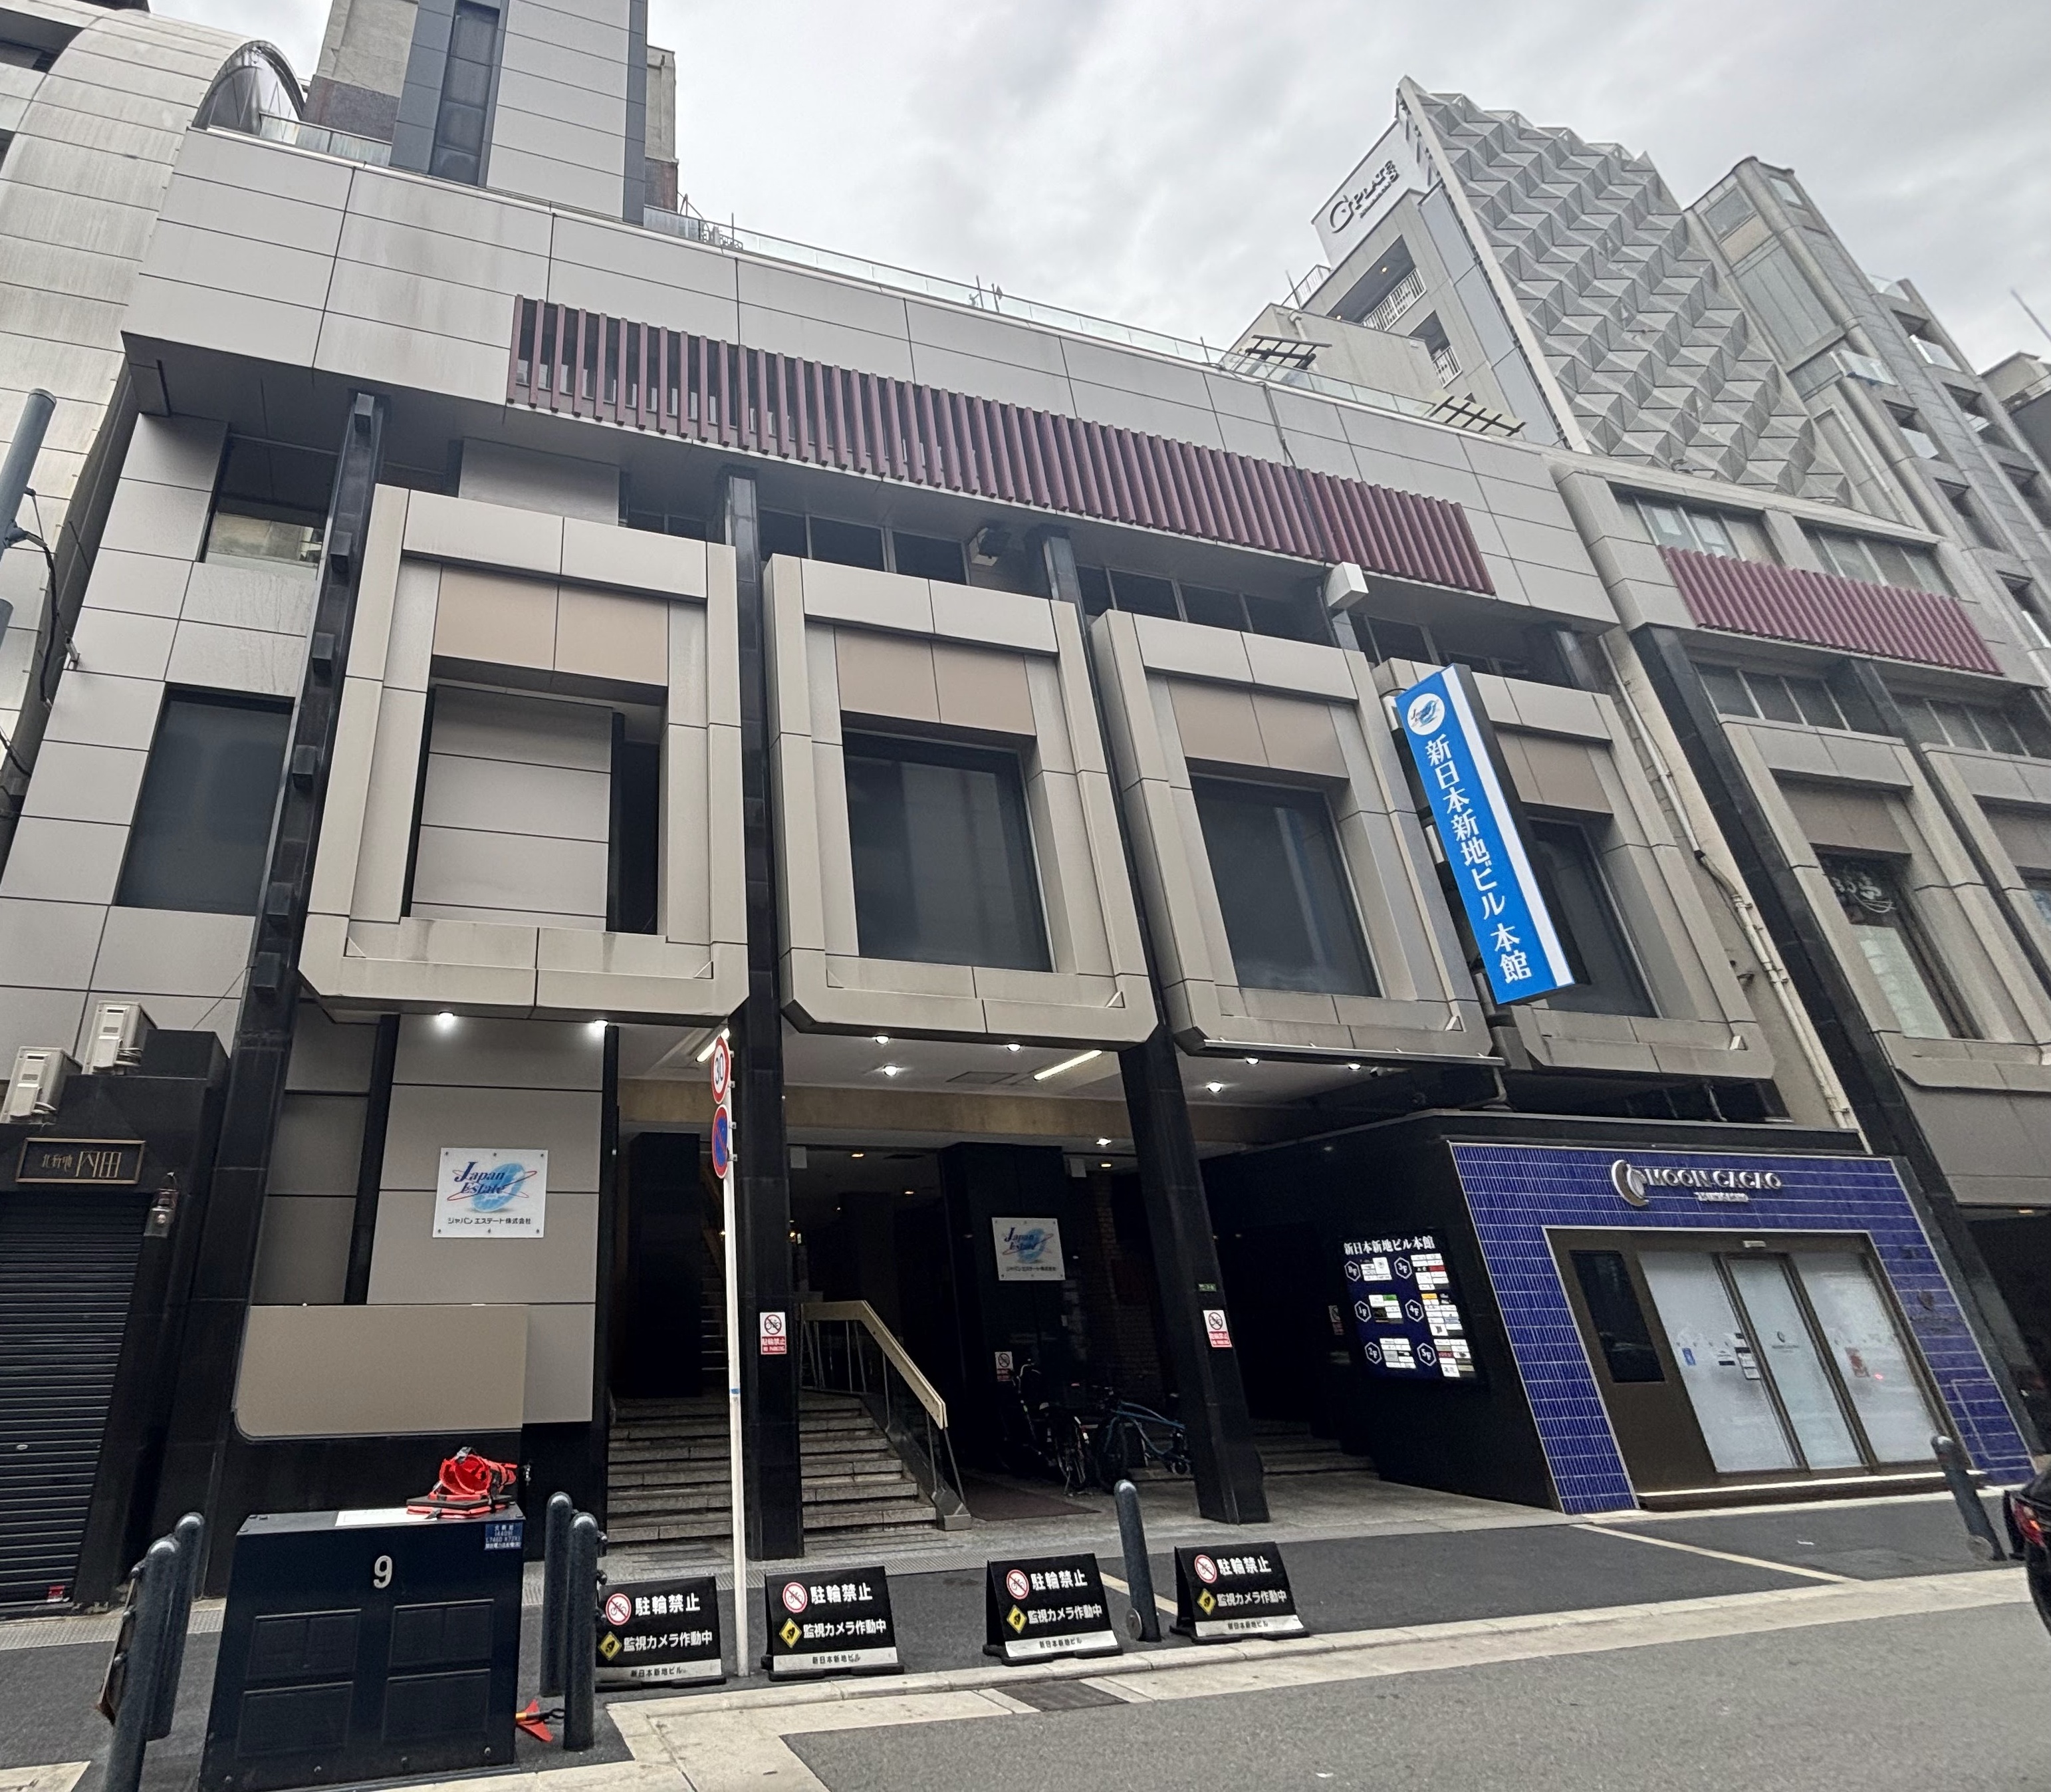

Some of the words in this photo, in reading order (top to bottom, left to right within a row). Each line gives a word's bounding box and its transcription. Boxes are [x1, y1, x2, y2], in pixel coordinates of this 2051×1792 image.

[1425, 733, 1532, 984] 新日本新地ビル本館
[715, 1053, 724, 1085] 30
[454, 1161, 505, 1183] Japan
[1644, 1168, 1711, 1187] MOON
[460, 1182, 506, 1194] Estate
[1344, 1235, 1435, 1255] 新日本新地ビル本館
[1398, 1263, 1408, 1275] 3F
[1409, 1305, 1419, 1317] 4F
[1368, 1347, 1378, 1359] 2F
[374, 1555, 393, 1589] 9
[1217, 1555, 1271, 1575] 駐輪禁止
[1030, 1569, 1088, 1591] 駐輪禁止
[810, 1582, 873, 1604] 駐輪禁止
[1216, 1590, 1287, 1606] 監視カメラ作動中
[635, 1593, 700, 1616] 駐輪禁止
[1027, 1604, 1102, 1625] 監視カメラ作動中
[803, 1618, 887, 1639] 監視カメラ作動中
[624, 1630, 713, 1652] 監視カメラ作動中
